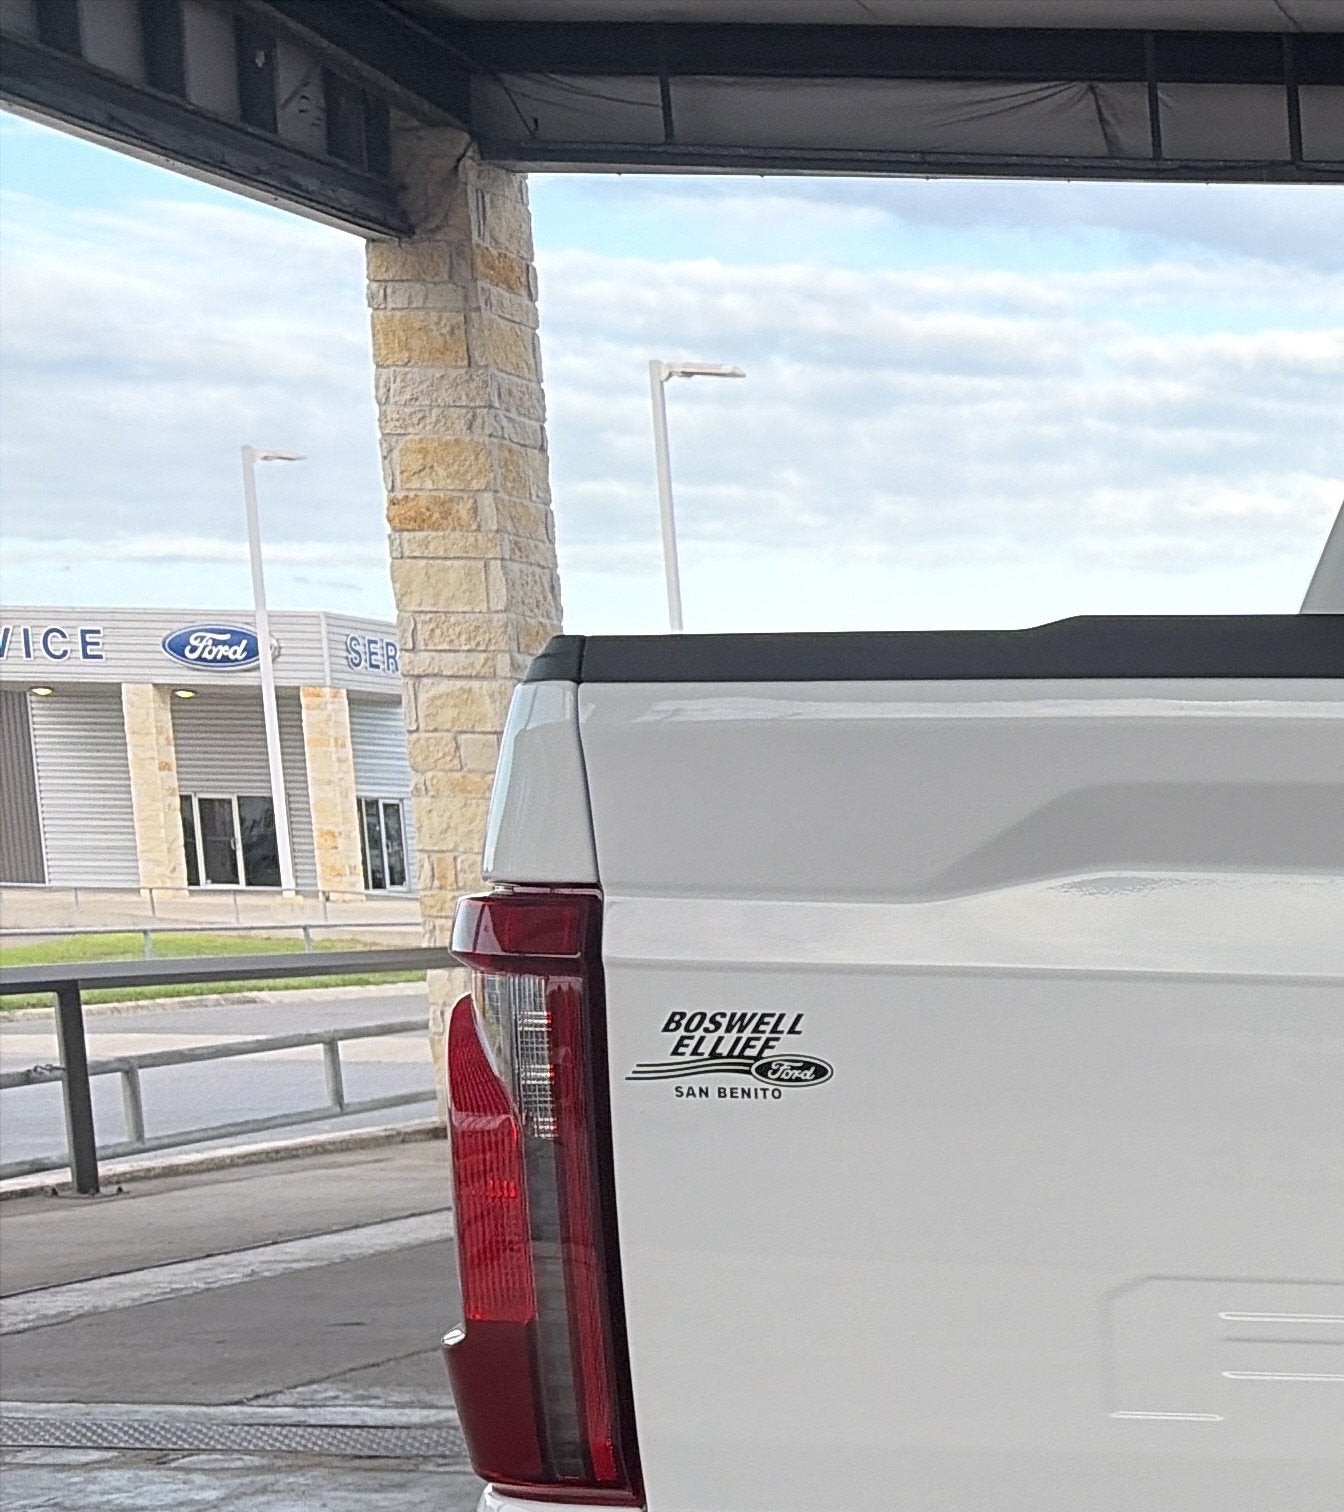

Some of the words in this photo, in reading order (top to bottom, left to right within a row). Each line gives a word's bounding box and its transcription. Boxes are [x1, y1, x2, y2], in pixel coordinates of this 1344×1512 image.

[184, 632, 247, 660] Ford
[661, 1011, 804, 1035] BOSWELL
[767, 1060, 815, 1081] Ford
[674, 1086, 709, 1099] SAN
[717, 1087, 782, 1100] BENITO
